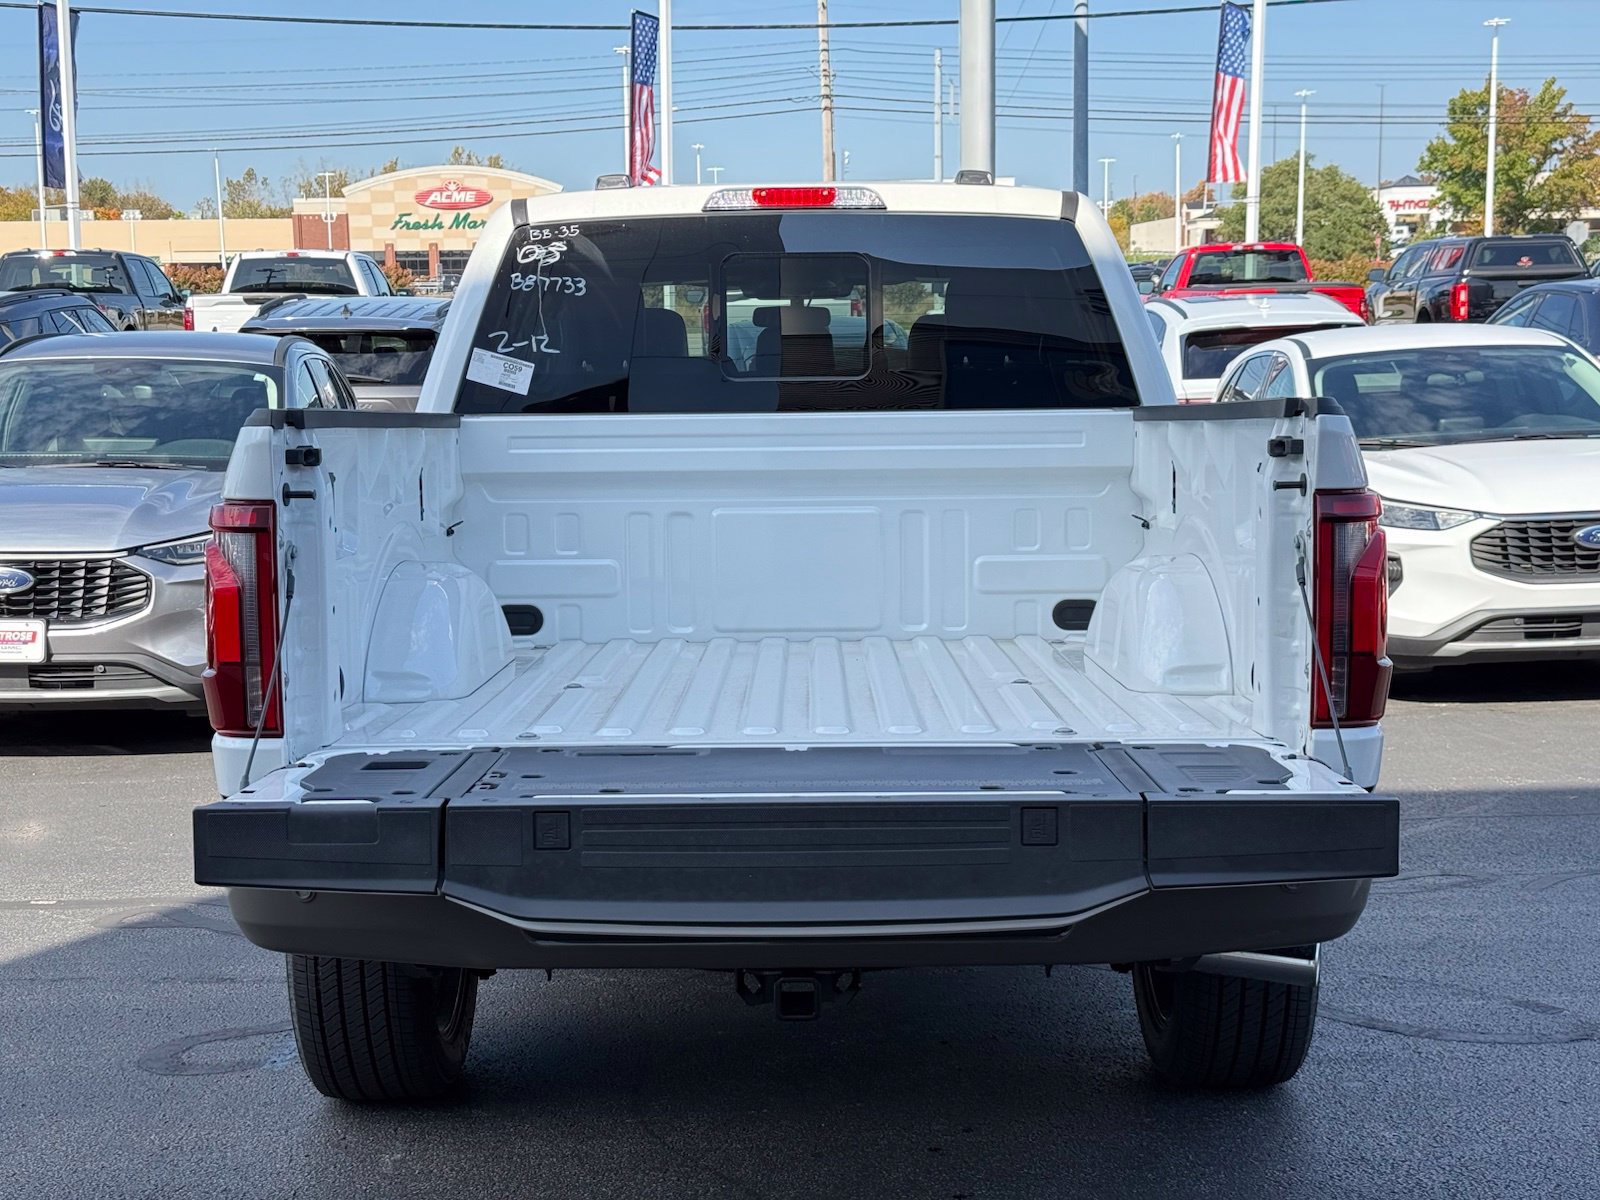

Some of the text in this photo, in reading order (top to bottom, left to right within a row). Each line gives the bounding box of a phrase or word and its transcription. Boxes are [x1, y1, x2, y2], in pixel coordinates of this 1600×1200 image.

[425, 190, 476, 205] ACME
[390, 212, 487, 231] Fresh Mar
